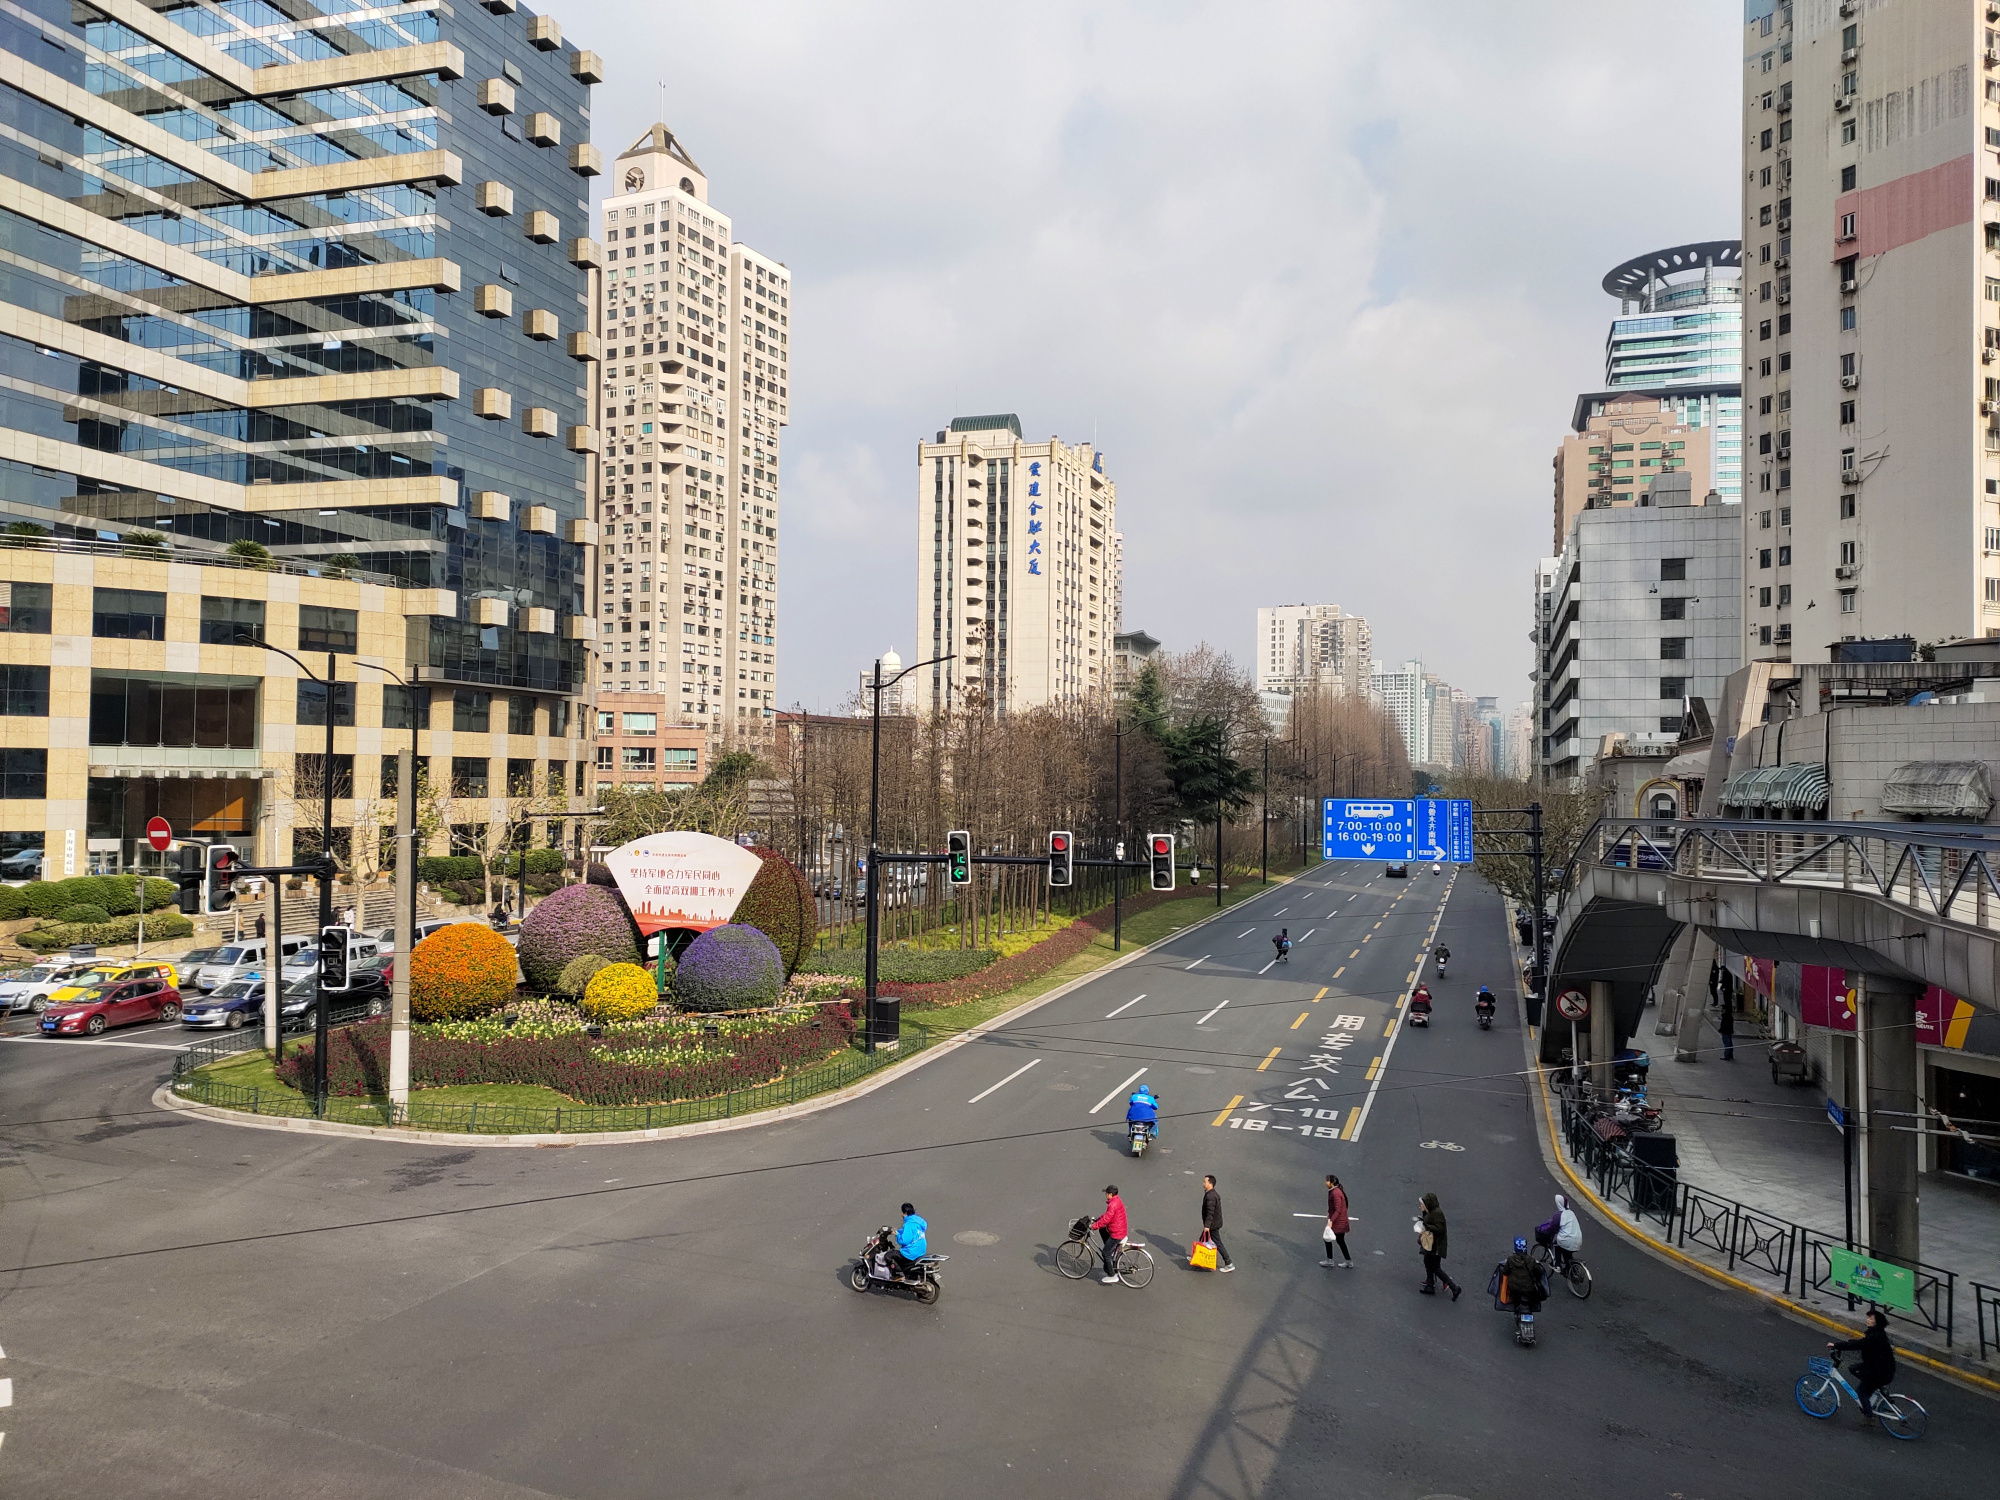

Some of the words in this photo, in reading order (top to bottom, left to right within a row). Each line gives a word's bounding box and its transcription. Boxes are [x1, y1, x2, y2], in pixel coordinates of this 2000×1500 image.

[1337, 821, 1402, 832] 7:00-10:00
[1337, 832, 1402, 842] 16:00-19:00
[630, 868, 720, 881] 坚持军地合力军民同心
[644, 884, 735, 898] 全面提高双拥工作水平
